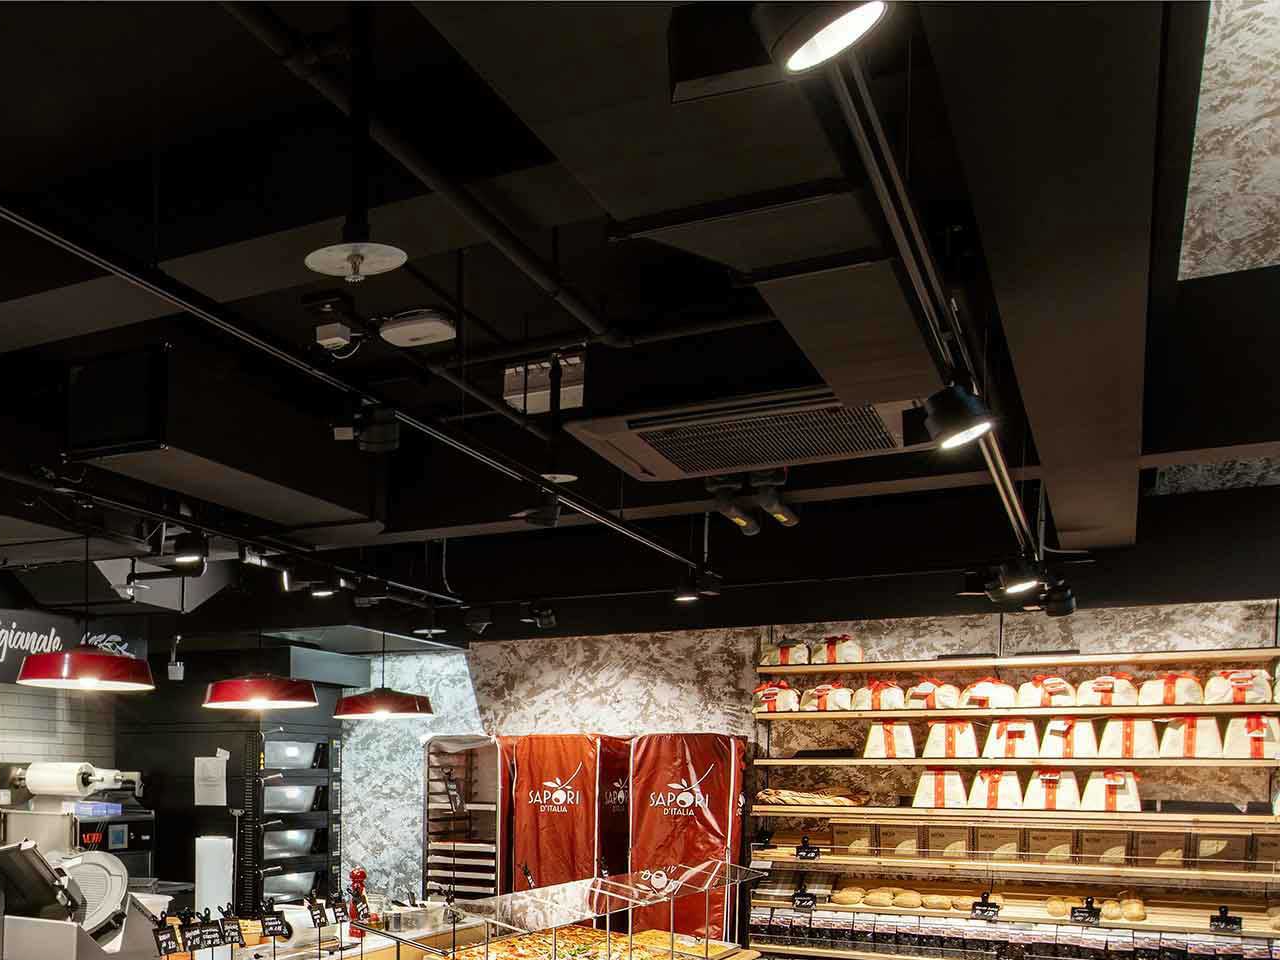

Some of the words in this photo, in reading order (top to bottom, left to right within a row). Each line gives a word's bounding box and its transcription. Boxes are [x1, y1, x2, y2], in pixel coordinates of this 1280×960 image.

[528, 788, 580, 805] SAPORI
[649, 789, 709, 808] SAPORI
[540, 805, 568, 813] D'ITALIA
[663, 807, 695, 817] D'ITALIA
